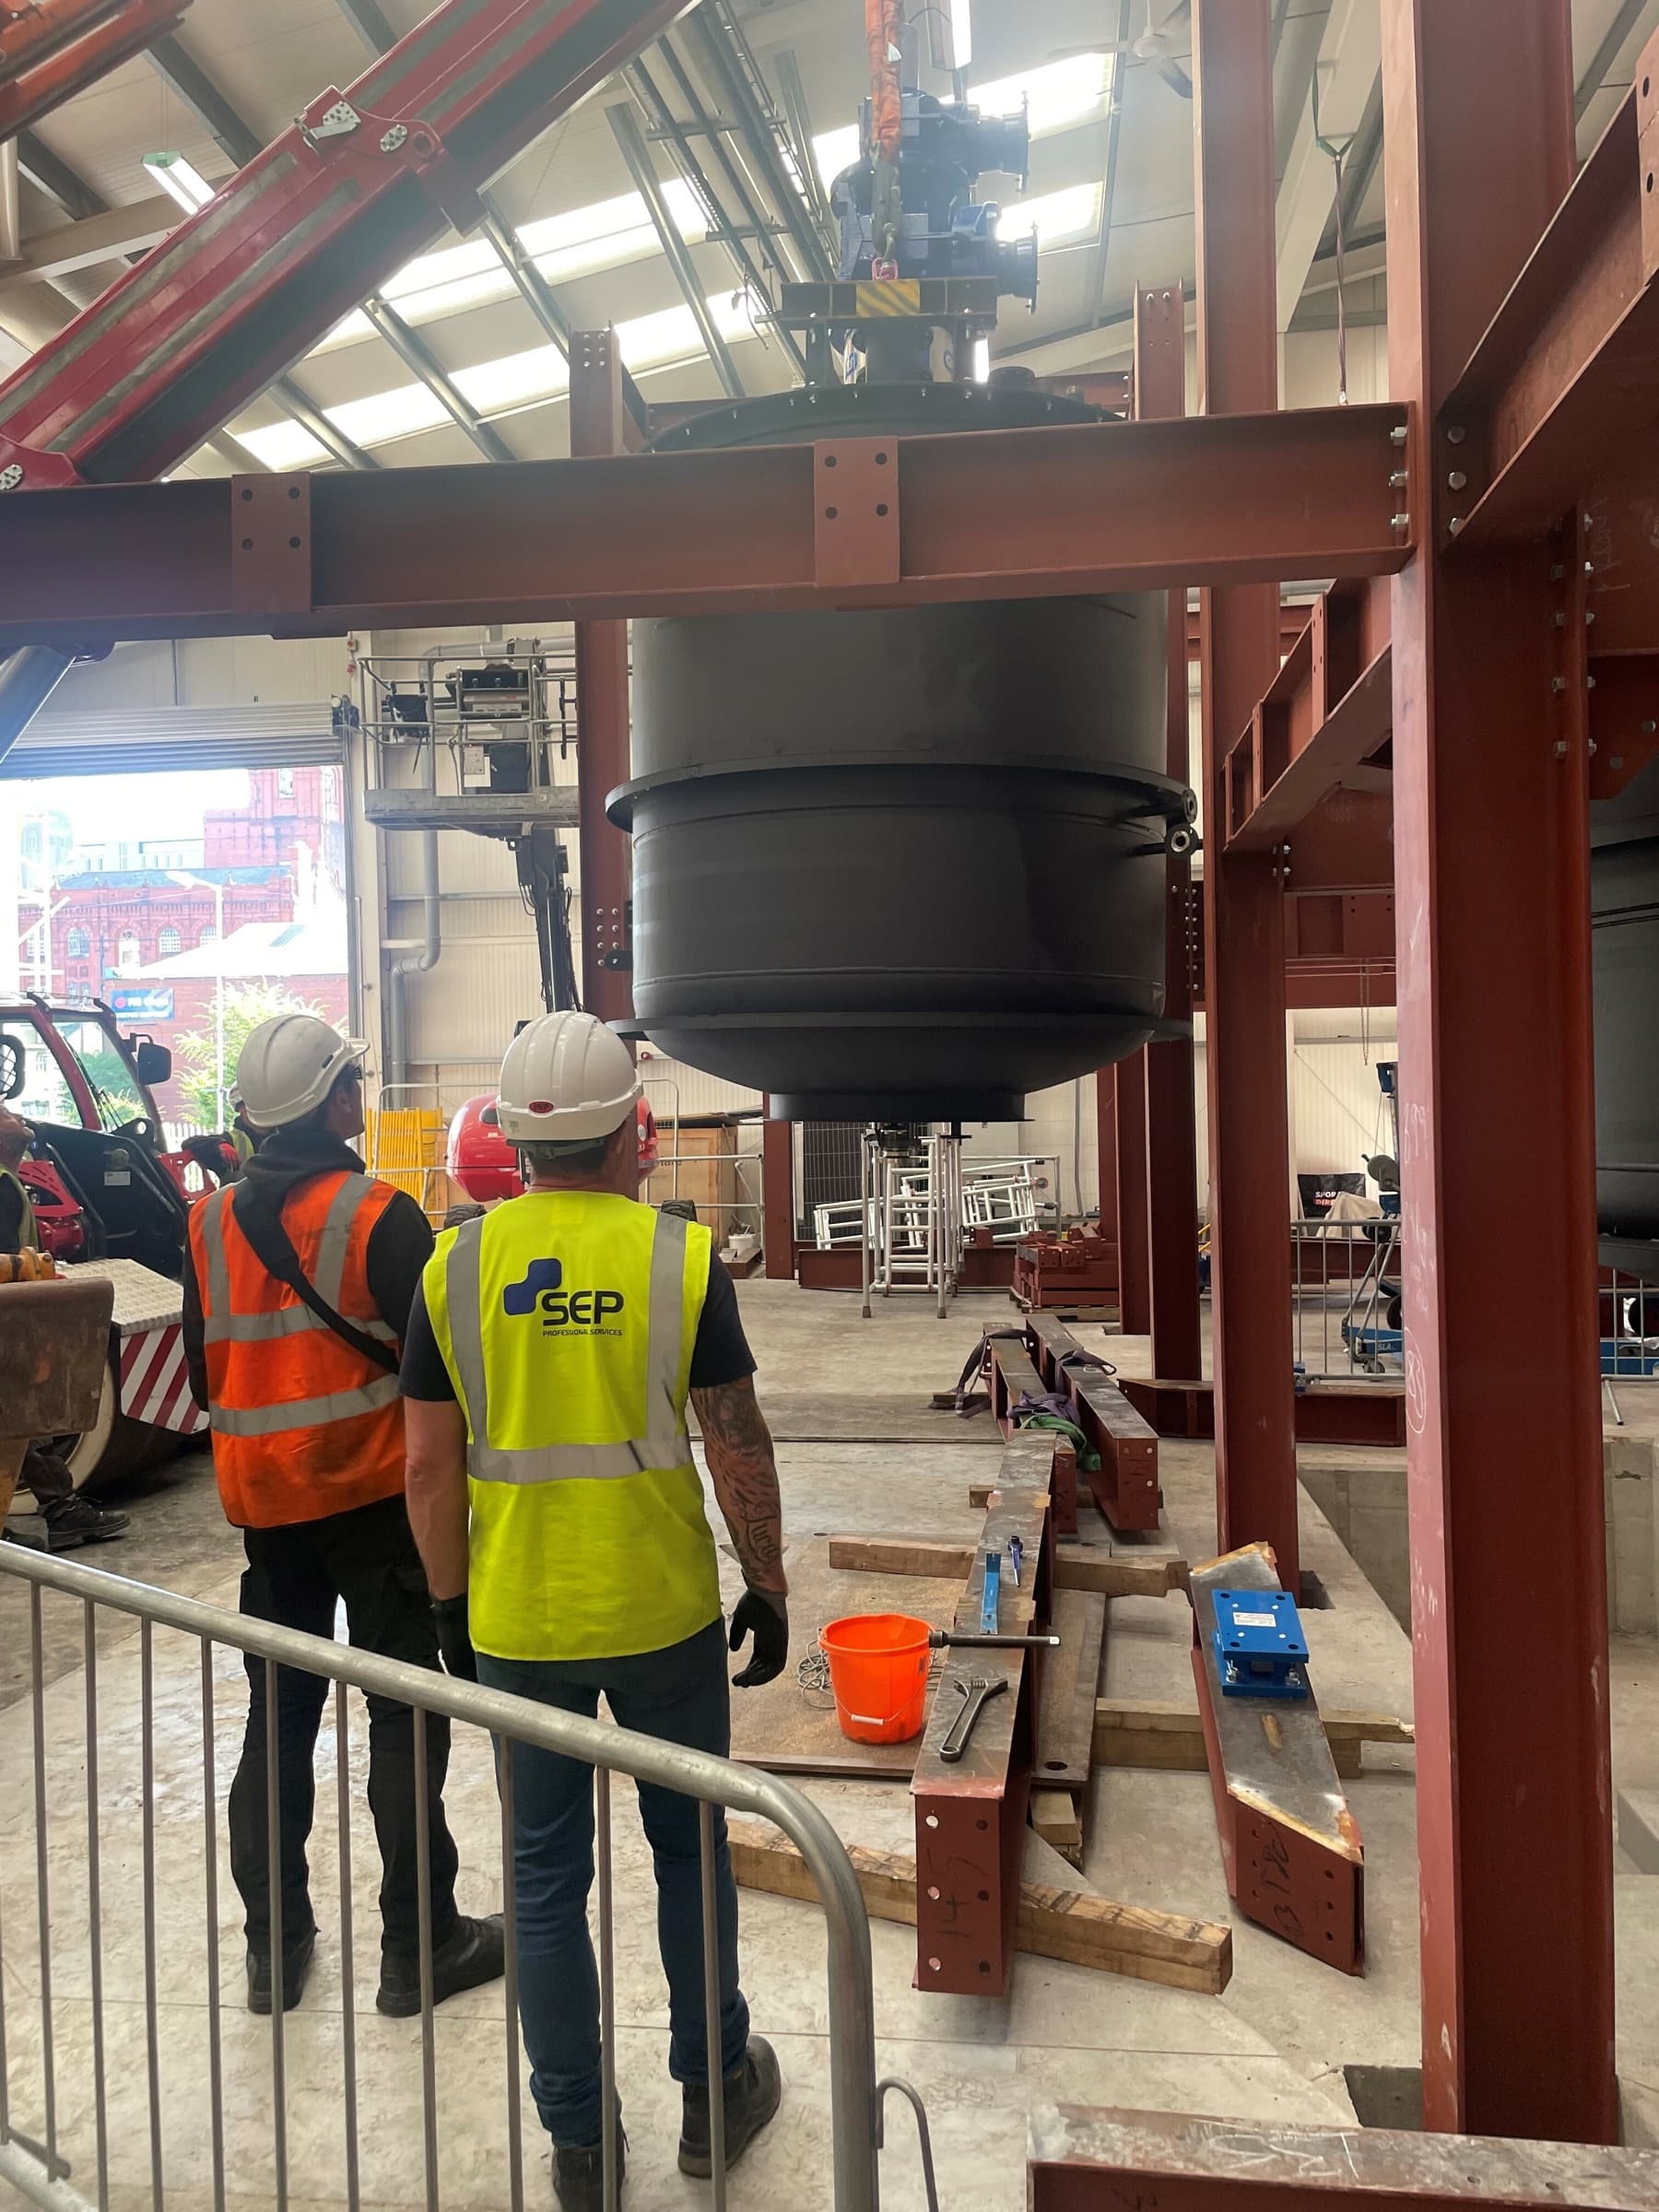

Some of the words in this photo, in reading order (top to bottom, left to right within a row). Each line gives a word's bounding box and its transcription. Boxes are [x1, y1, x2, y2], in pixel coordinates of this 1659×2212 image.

[541, 1290, 624, 1326] SEP
[543, 1328, 589, 1337] PROFESSIONAL
[590, 1327, 623, 1336] SERVICES
